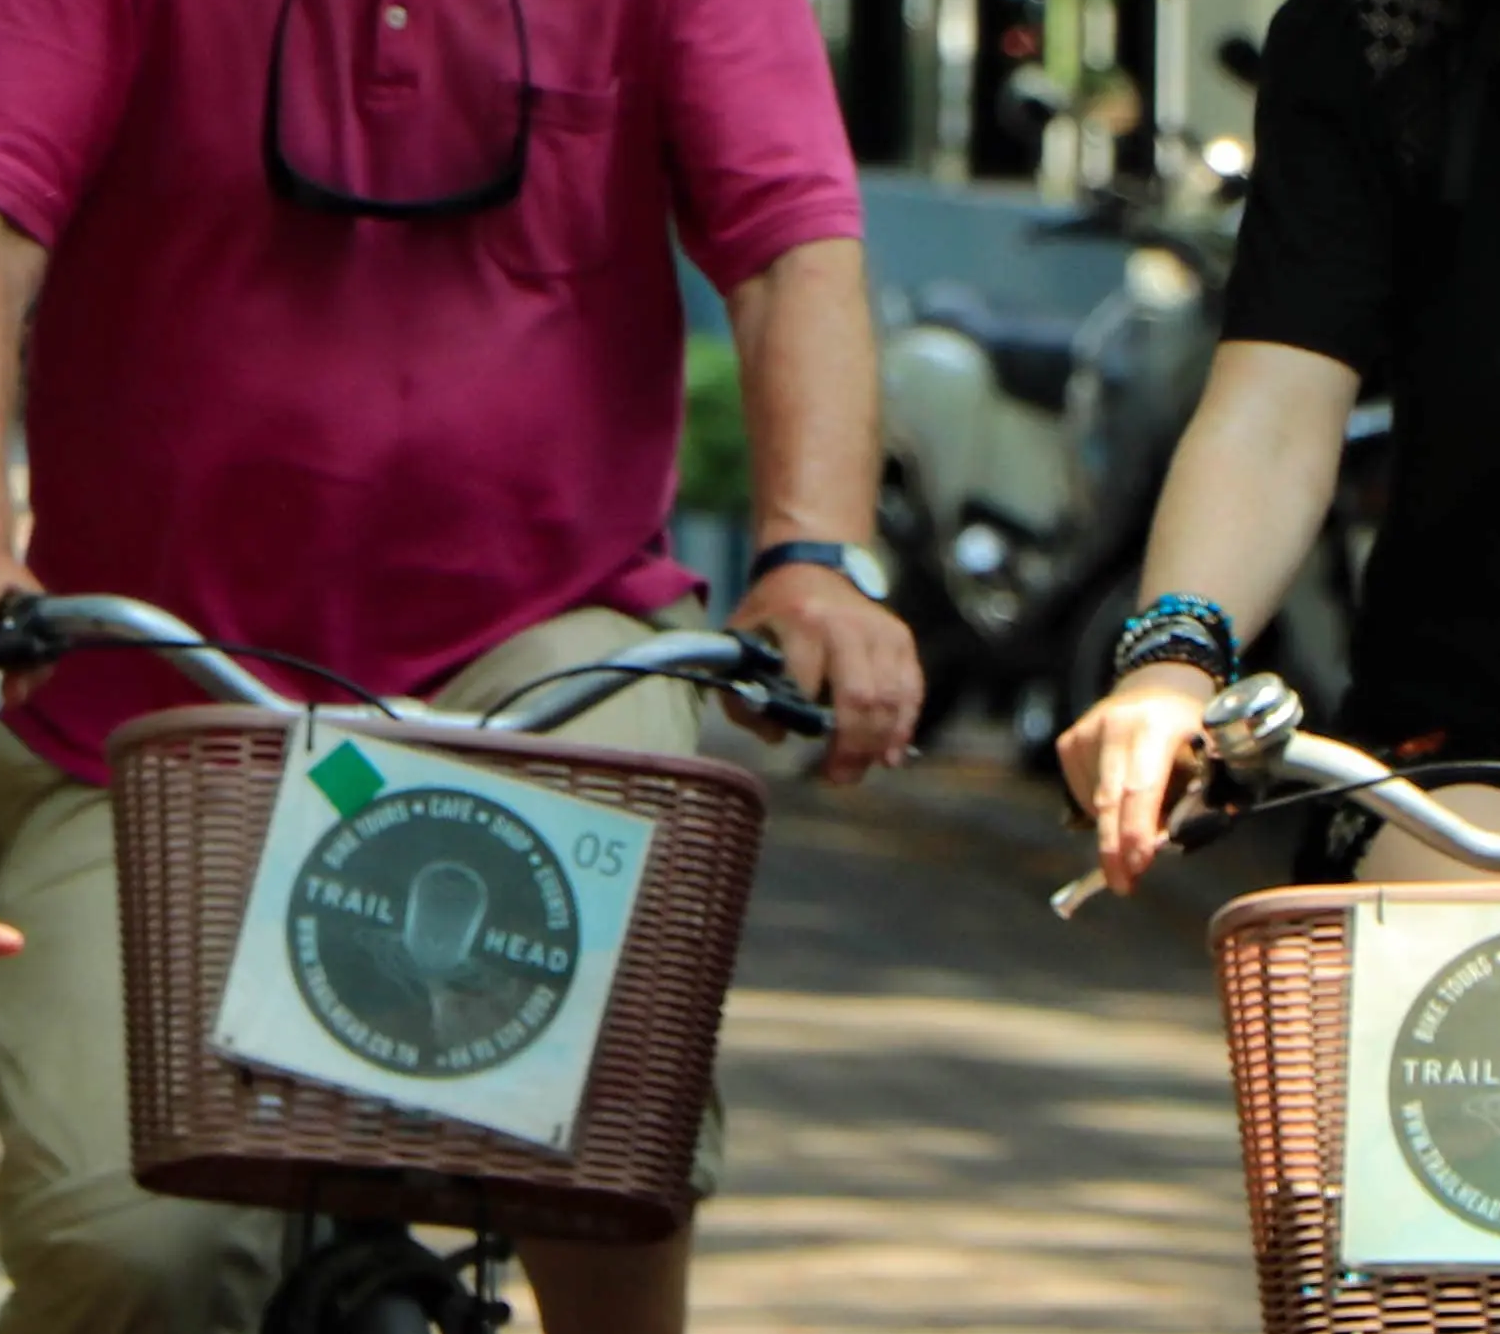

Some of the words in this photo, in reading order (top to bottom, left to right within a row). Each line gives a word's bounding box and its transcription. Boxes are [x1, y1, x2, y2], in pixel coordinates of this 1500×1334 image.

[572, 830, 628, 877] 05
[303, 874, 394, 925] TRAIL
[483, 927, 569, 973] HEAD
[1400, 1057, 1500, 1088] TRAIL
